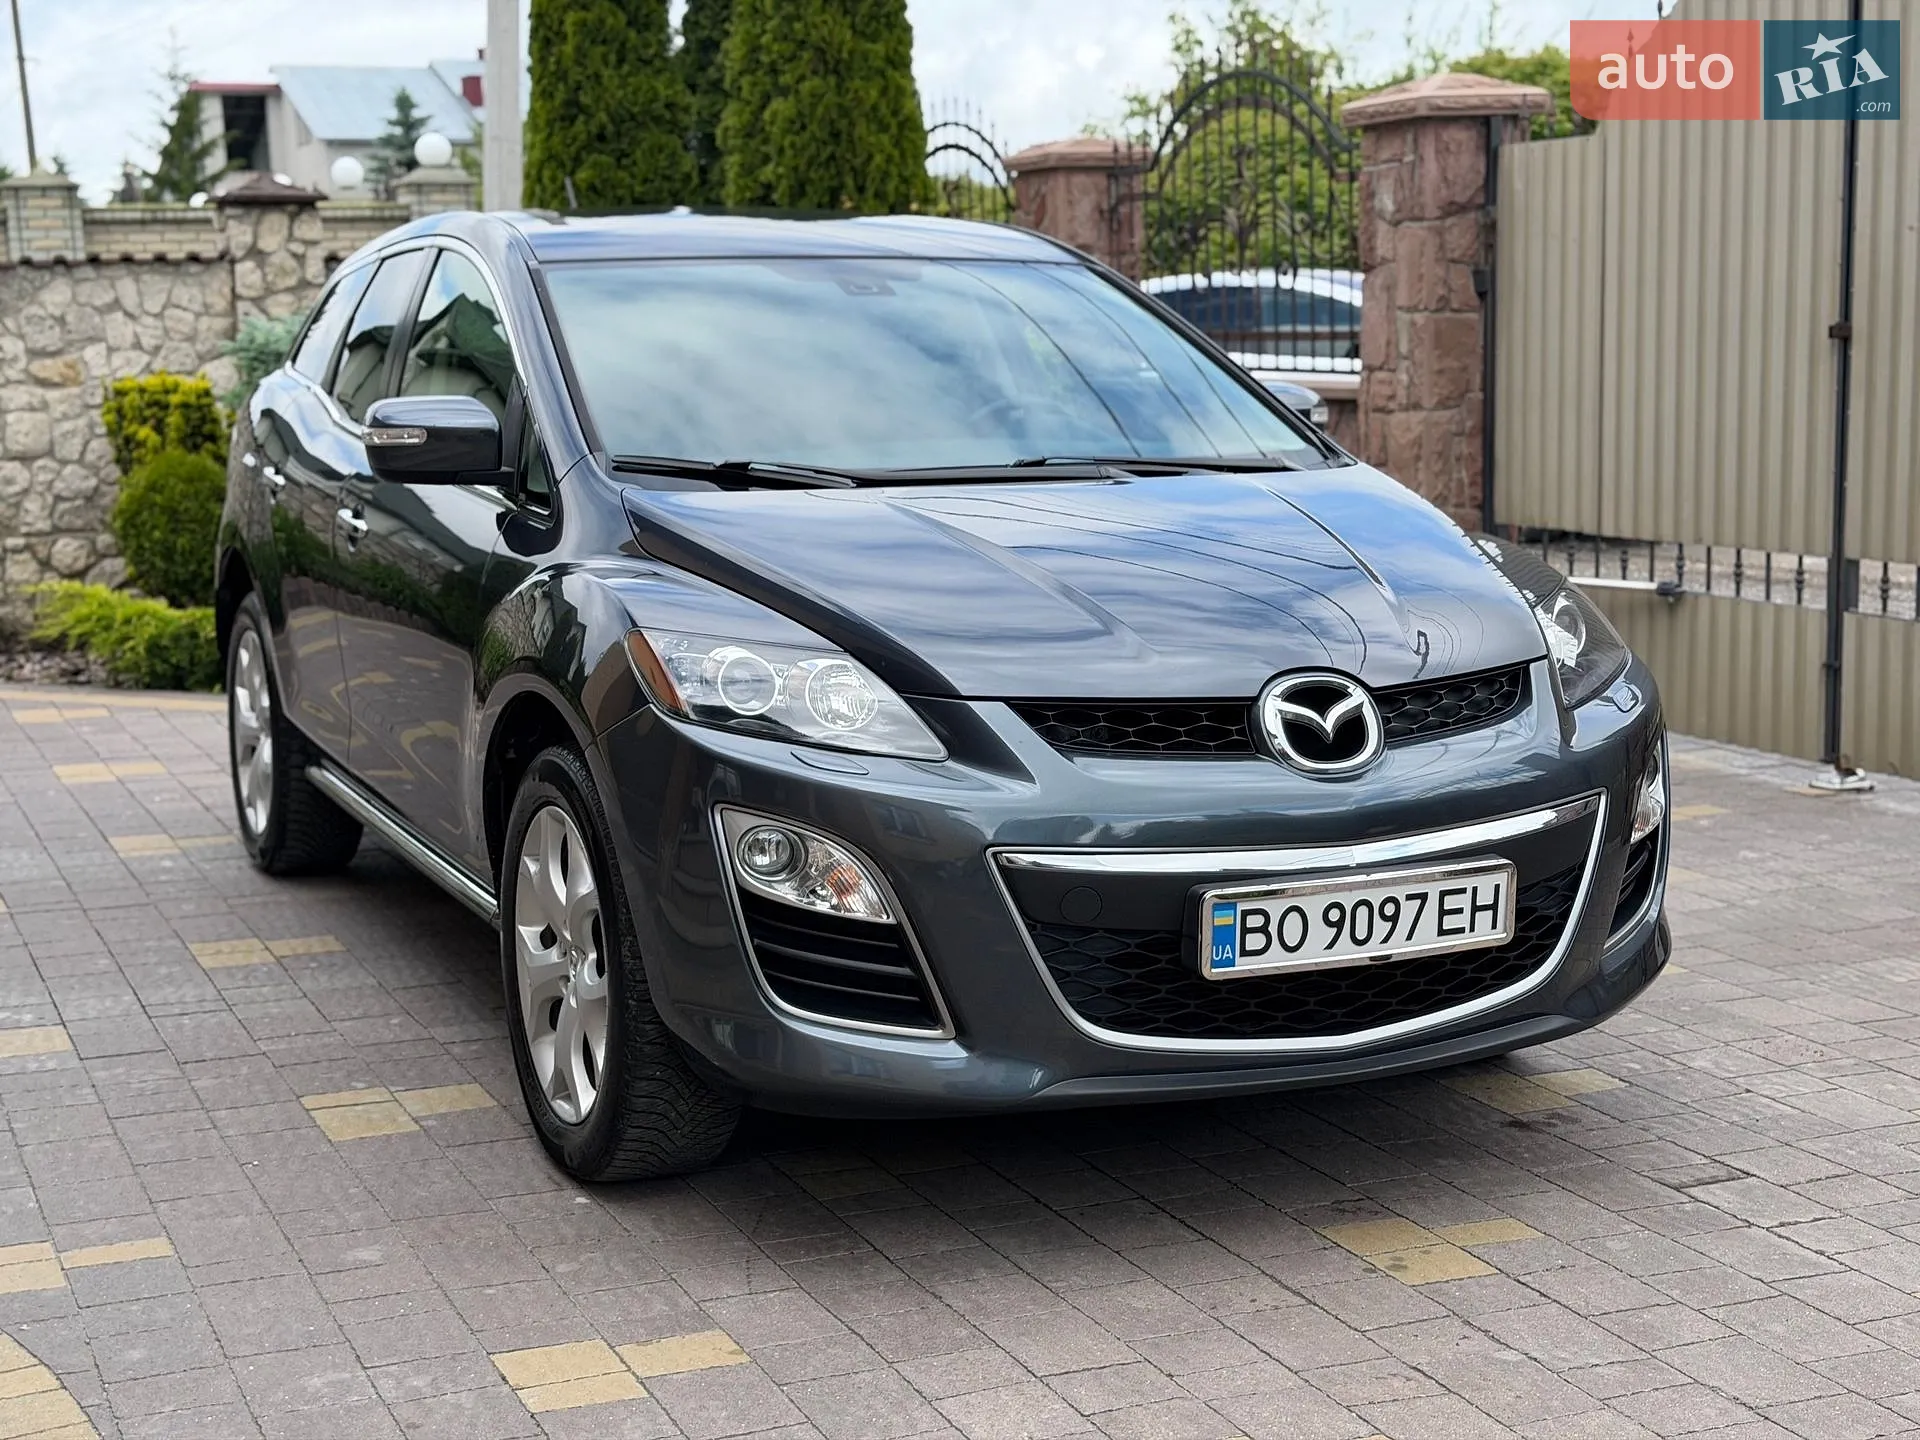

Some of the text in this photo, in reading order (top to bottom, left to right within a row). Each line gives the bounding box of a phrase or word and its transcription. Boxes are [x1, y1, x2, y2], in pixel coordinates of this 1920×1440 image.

[1239, 883, 1501, 957] BO 9097 EH
[1212, 944, 1233, 961] UA
